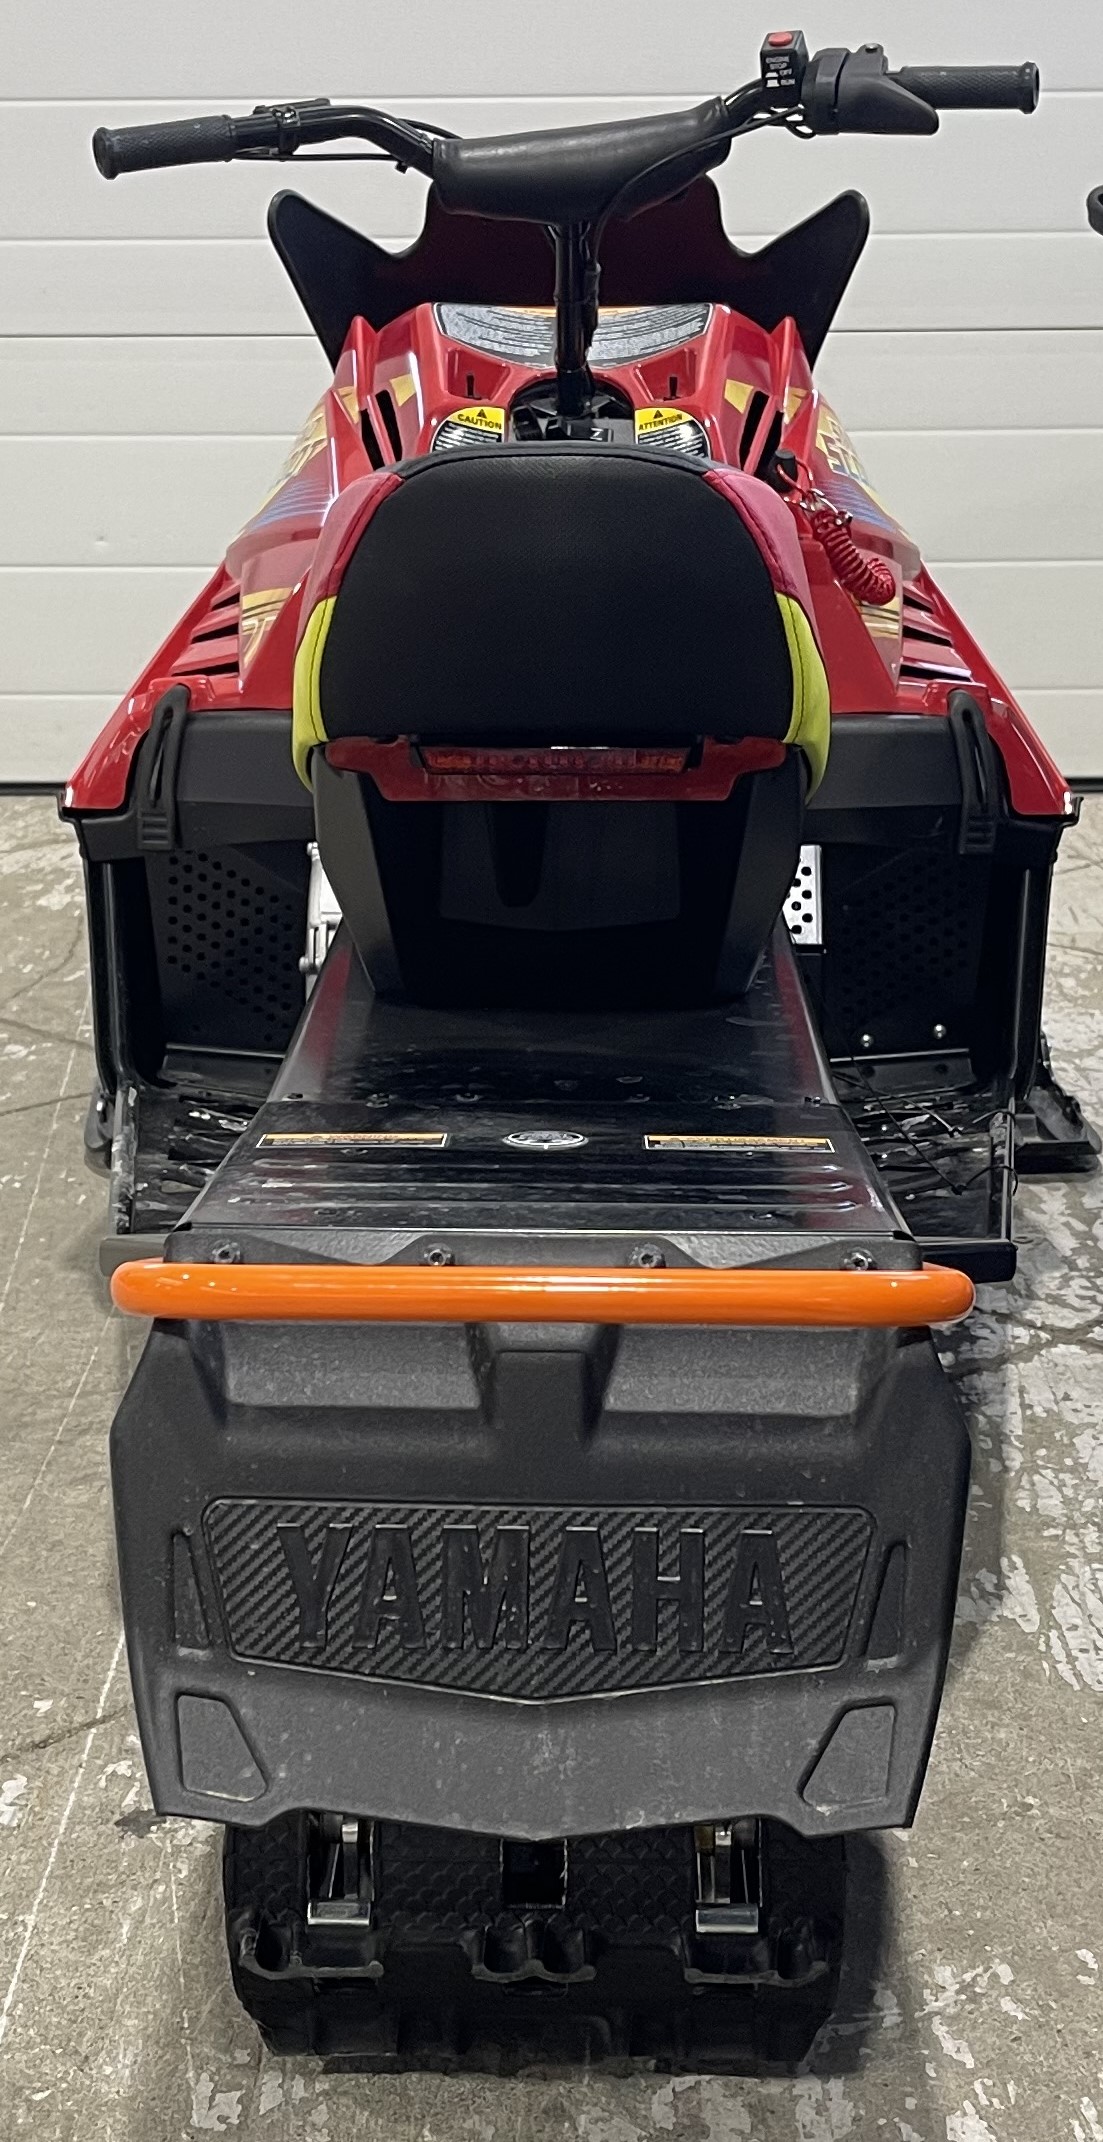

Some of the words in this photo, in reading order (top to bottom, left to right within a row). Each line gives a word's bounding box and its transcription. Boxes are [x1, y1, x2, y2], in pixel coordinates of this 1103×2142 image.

[457, 413, 502, 430] CAUTION
[638, 413, 683, 431] ATTENTION
[276, 1522, 794, 1655] YAMAHA
